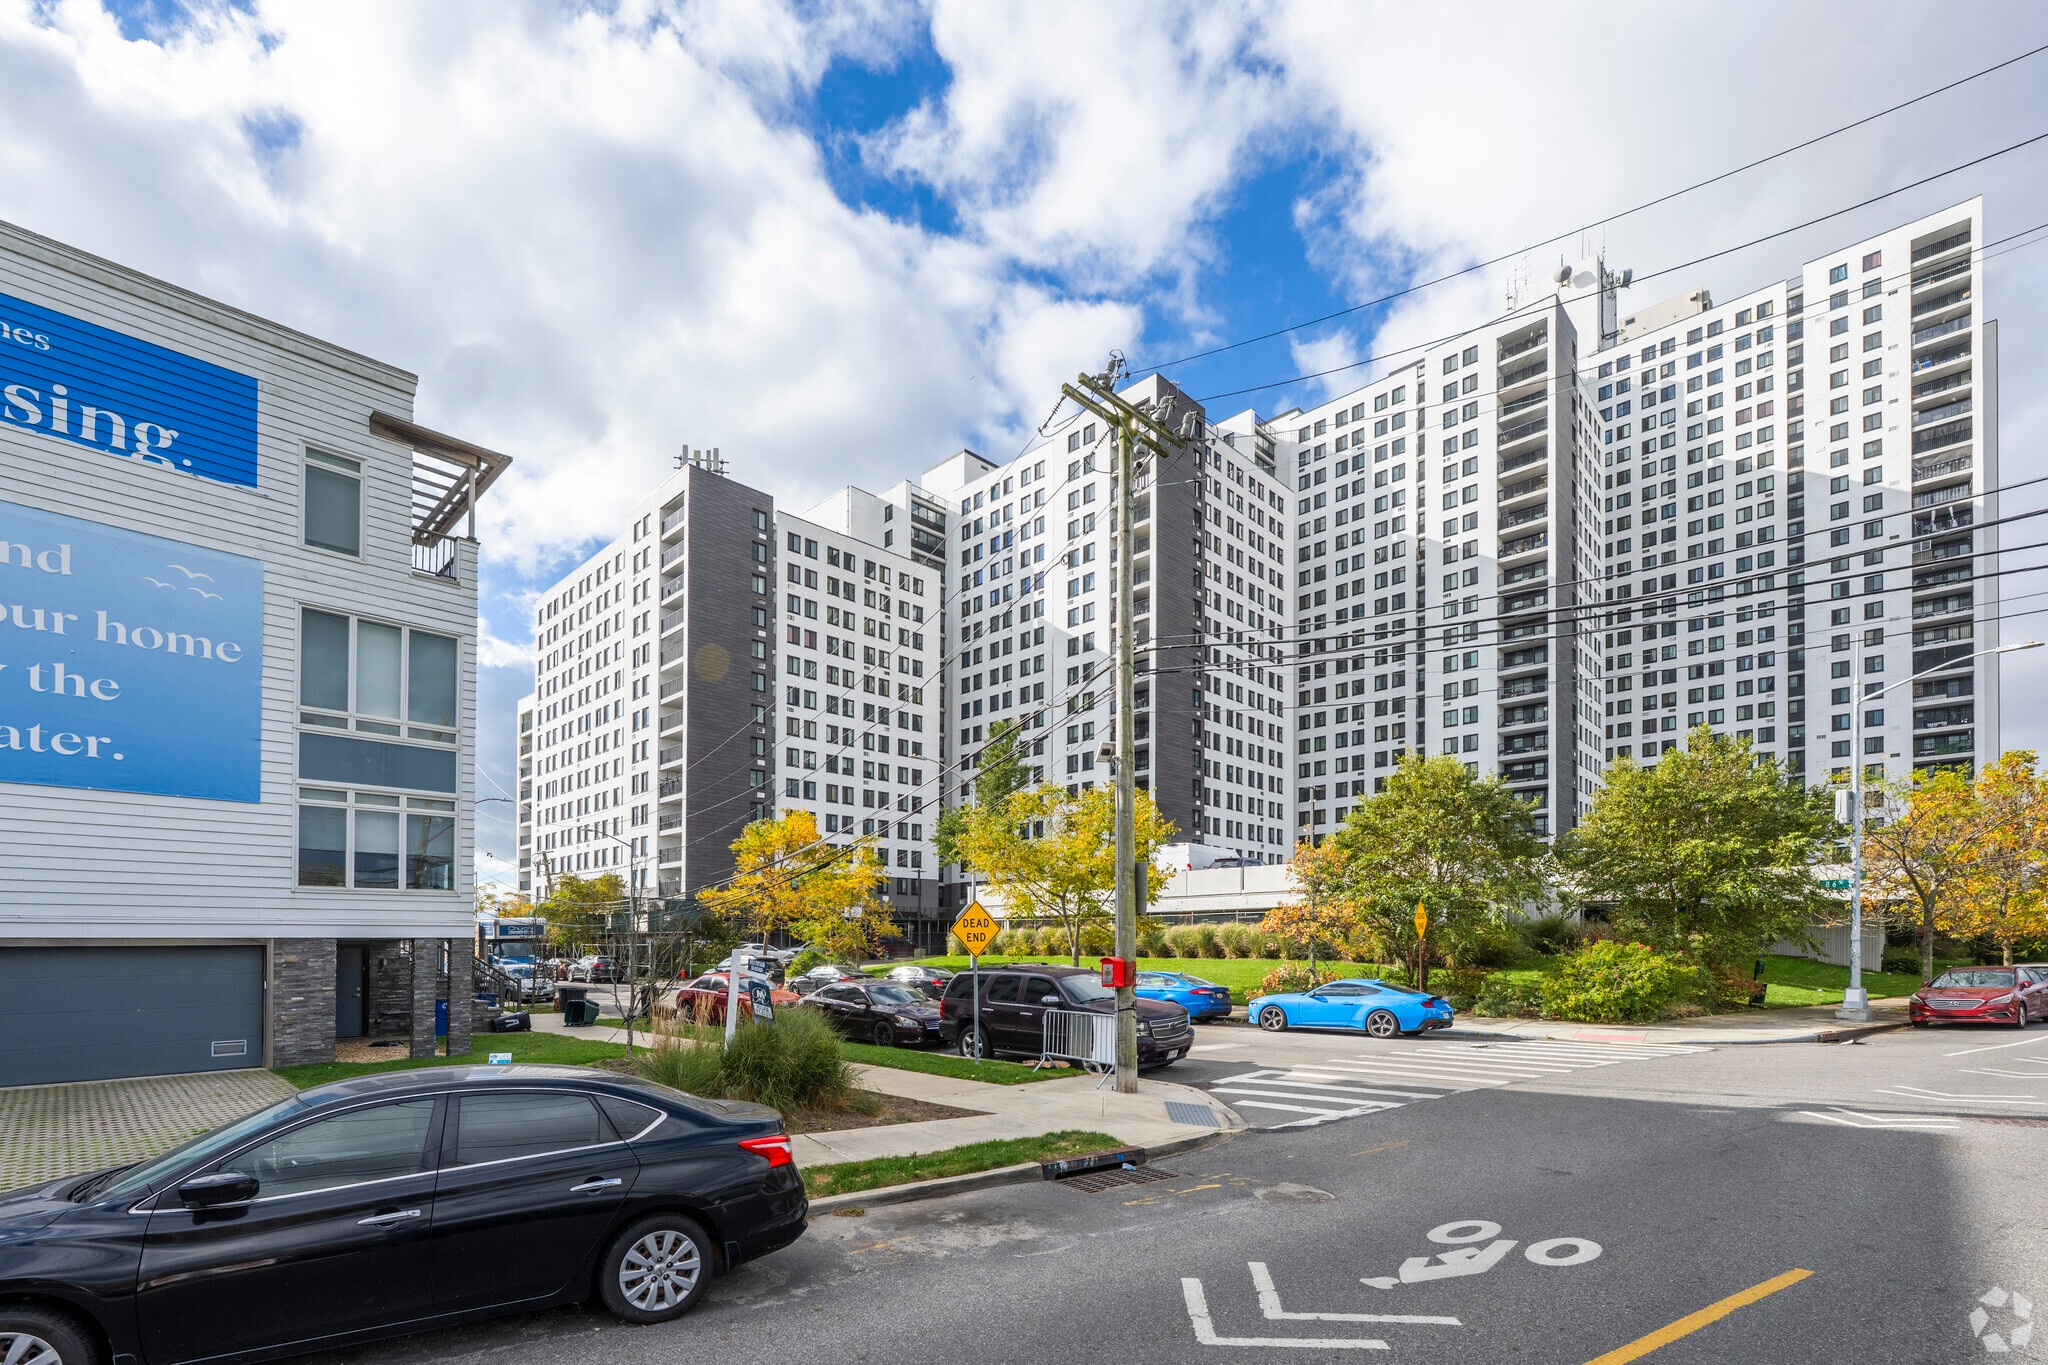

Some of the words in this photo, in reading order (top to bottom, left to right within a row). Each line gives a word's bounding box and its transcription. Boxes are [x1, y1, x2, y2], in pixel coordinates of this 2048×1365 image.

[4, 384, 192, 469] sing.
[0, 541, 72, 575] nd
[0, 604, 78, 635] ur
[94, 610, 243, 663] home
[26, 662, 122, 701] the
[0, 723, 124, 761] ater.
[962, 918, 990, 928] DEAD
[966, 932, 986, 942] END
